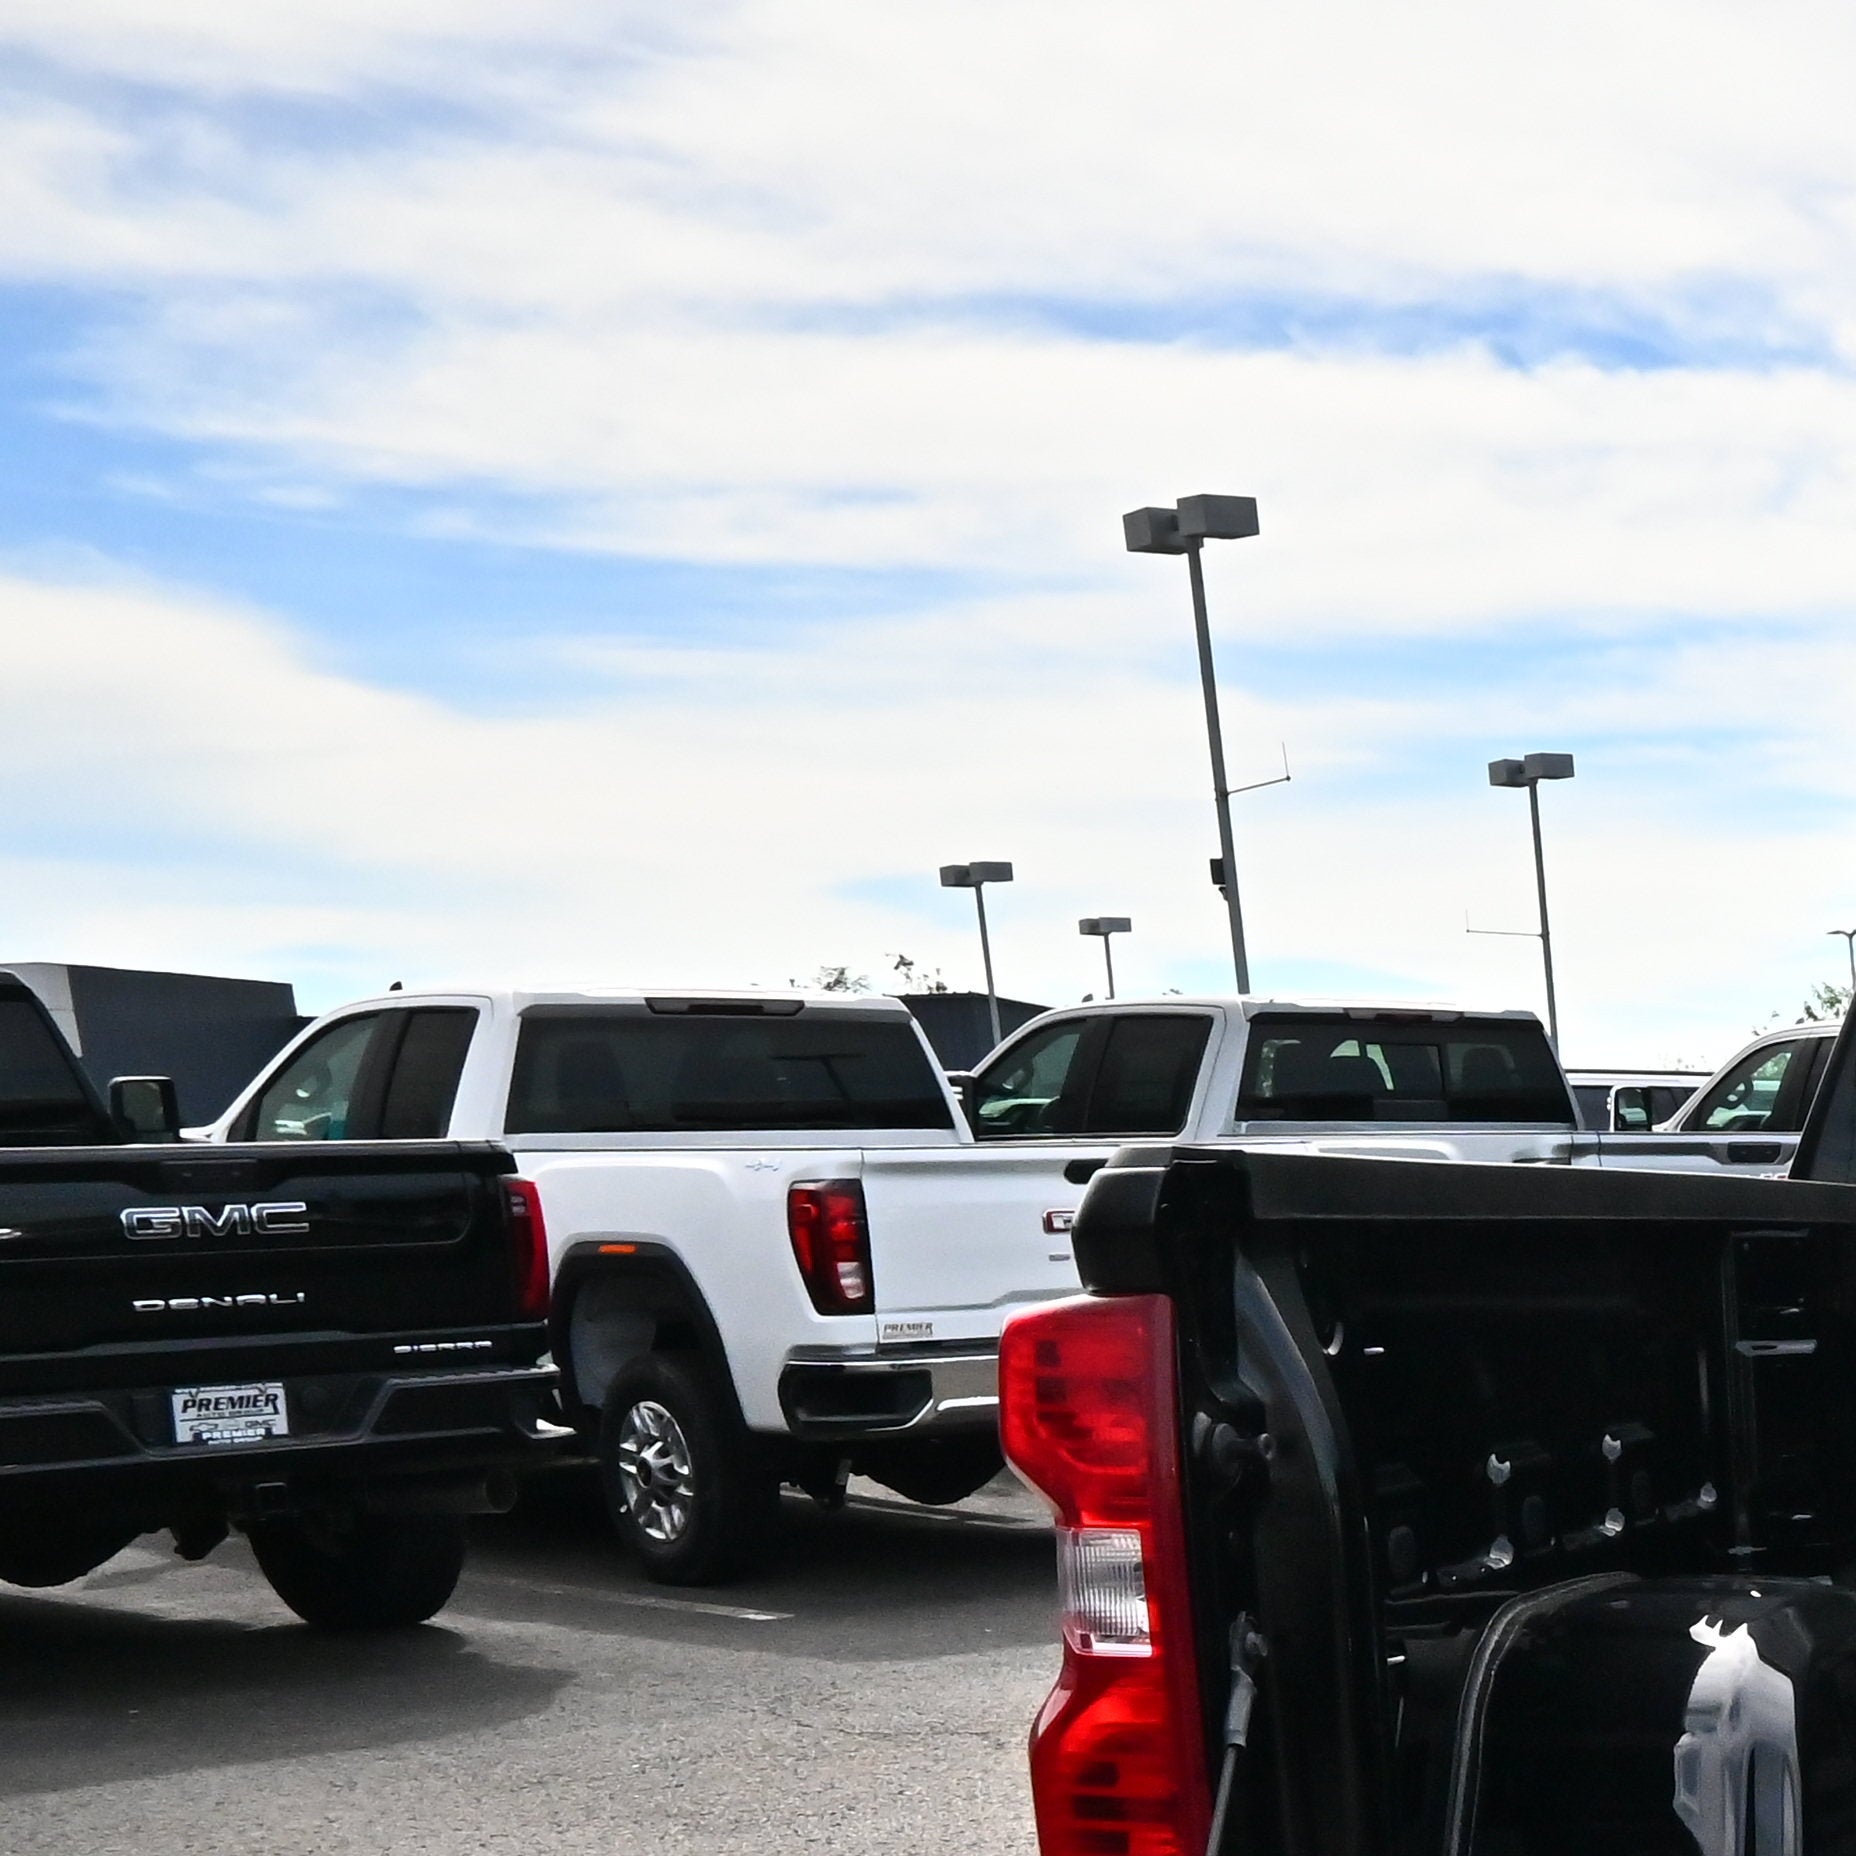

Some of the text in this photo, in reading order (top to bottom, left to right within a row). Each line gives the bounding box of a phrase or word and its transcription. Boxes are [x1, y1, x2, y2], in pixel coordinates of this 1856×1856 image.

[120, 1202, 310, 1240] GMC
[132, 1292, 305, 1312] DENALI
[393, 1340, 493, 1354] SIERRA
[181, 1393, 281, 1415] PREMIER
[202, 1428, 266, 1440] PREMIER
